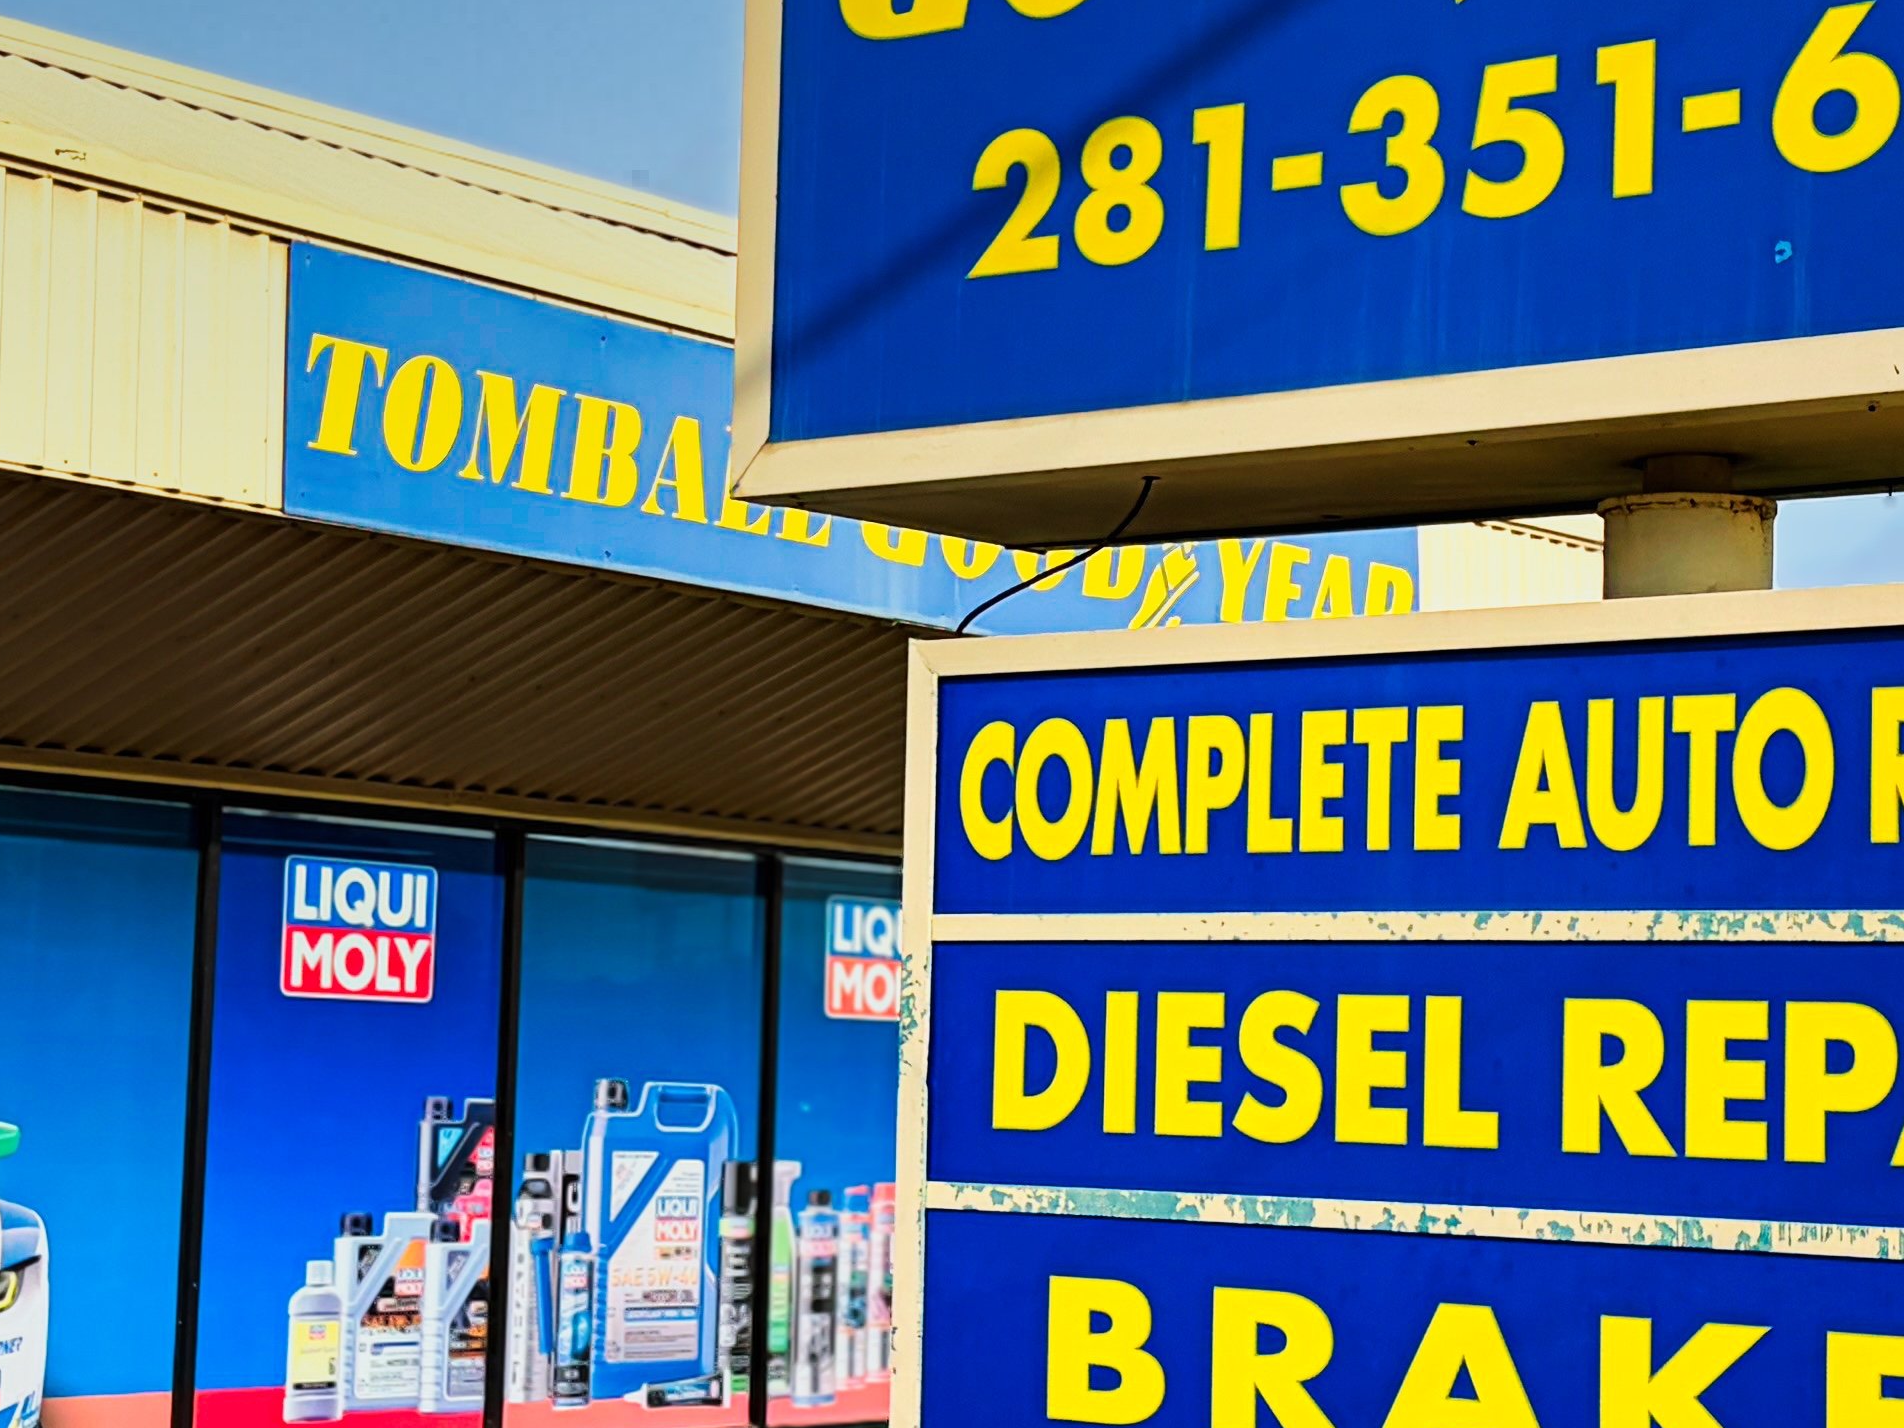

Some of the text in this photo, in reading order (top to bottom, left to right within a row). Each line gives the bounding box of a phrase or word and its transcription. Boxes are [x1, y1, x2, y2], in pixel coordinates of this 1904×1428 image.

[961, 705, 1463, 860] COMPLETE
[1500, 688, 1834, 851] AUTO
[294, 864, 428, 928] LIQUI
[290, 930, 431, 994] MOLY
[833, 903, 902, 959] LIQ
[992, 990, 1499, 1149] DIESEL
